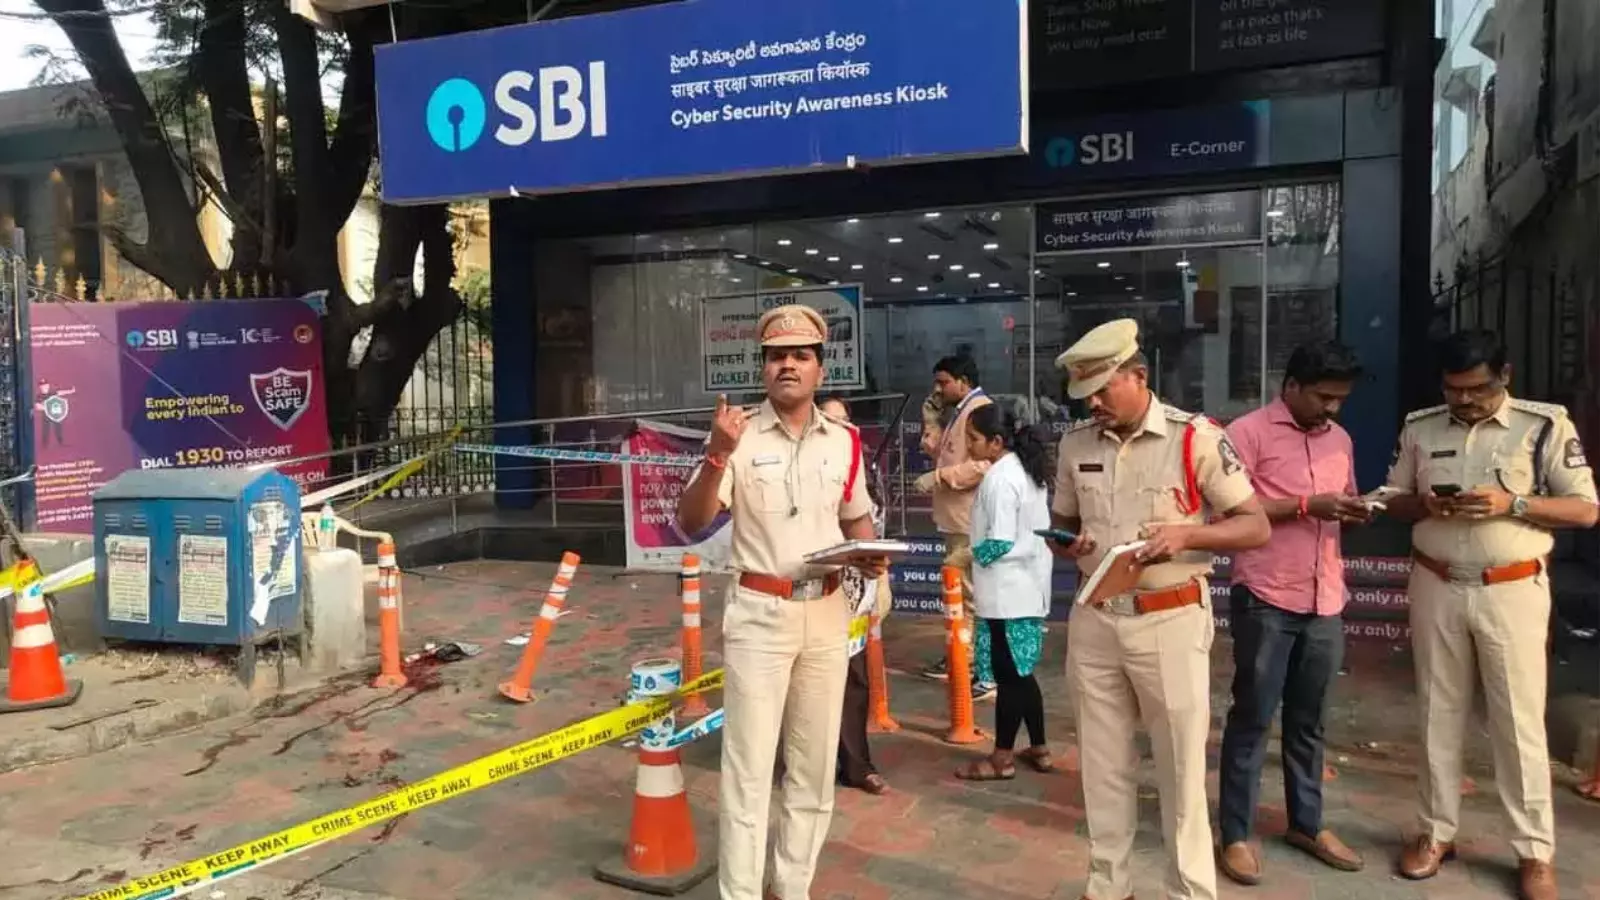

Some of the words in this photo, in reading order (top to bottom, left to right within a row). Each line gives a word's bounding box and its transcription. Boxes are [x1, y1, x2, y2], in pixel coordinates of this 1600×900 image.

[494, 60, 608, 146] SBI
[671, 107, 719, 129] Cyber
[722, 100, 793, 120] Security
[796, 91, 893, 113] Awareness
[896, 82, 948, 103] Kiosk
[1079, 131, 1134, 165] SBI
[1170, 140, 1245, 158] E-Corner
[1044, 234, 1080, 248] Cyber
[1082, 228, 1134, 243] Security
[145, 329, 178, 347] SBI
[272, 376, 291, 388] BE
[265, 386, 301, 398] Scam
[145, 394, 229, 411] Empowering
[265, 398, 302, 411] SAFE
[146, 408, 185, 421] every
[187, 404, 228, 417] Indian
[230, 403, 244, 414] to
[141, 456, 173, 470] DIAL
[175, 446, 225, 466] 1930
[226, 450, 244, 462] TO
[245, 444, 293, 459] REPORT
[911, 543, 933, 553] you
[903, 571, 926, 582] you
[894, 598, 917, 609] you
[1356, 590, 1390, 605] only
[1364, 623, 1400, 639] only
[488, 759, 520, 780] CRIME
[523, 748, 554, 768] SCENE
[562, 739, 586, 754] KEEP
[588, 727, 613, 745] AWAY
[312, 816, 356, 836] CRIME
[357, 800, 399, 822] SCENE
[407, 788, 438, 806] KEEP
[441, 775, 471, 795] AWAY
[137, 865, 193, 889] SCENE
[205, 848, 246, 870] KEEP
[250, 834, 290, 857] AWAY
